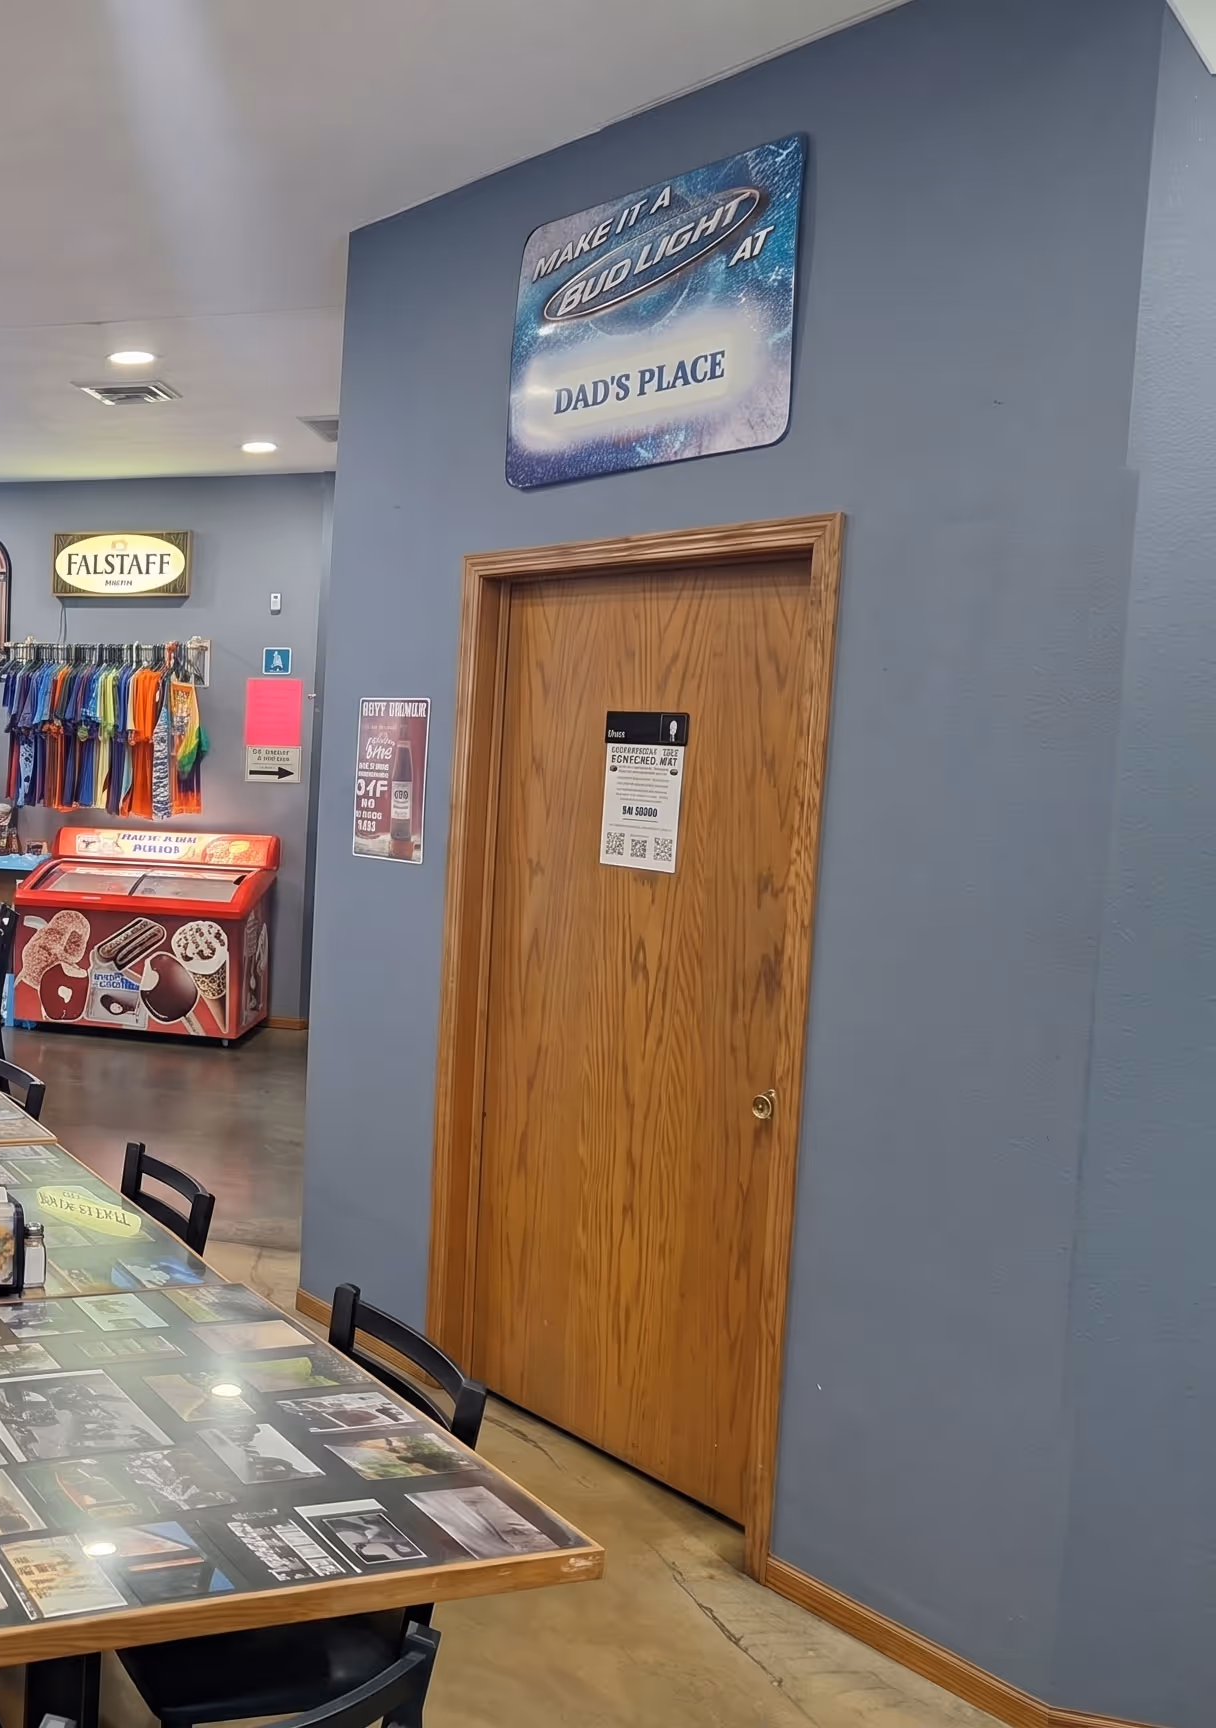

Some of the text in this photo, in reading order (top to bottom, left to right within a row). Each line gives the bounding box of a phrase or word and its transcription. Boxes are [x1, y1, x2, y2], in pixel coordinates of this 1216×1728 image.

[531, 186, 672, 283] MAKE IT A
[557, 191, 751, 317] BUD LIGHT
[729, 225, 774, 268] AT
[553, 350, 726, 415] DAD'S PLACE
[66, 553, 171, 576] FALSTAFF
